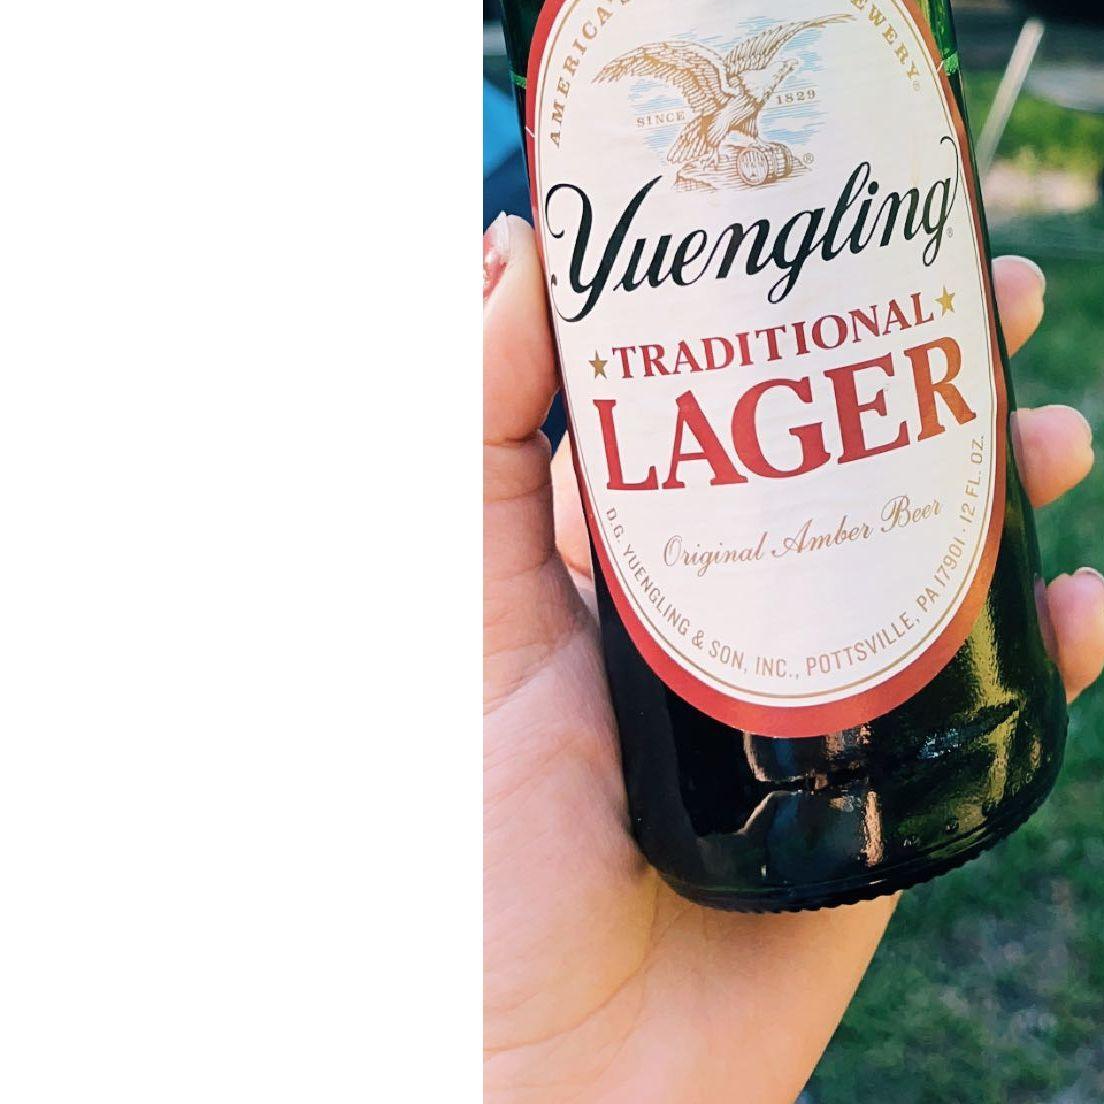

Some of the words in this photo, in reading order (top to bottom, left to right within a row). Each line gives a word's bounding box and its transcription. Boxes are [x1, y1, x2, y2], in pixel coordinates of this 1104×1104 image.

[636, 110, 686, 129] SINCE
[776, 89, 817, 105] 1829
[544, 135, 959, 323] Yuengling
[611, 291, 935, 380] TRADITIONAL
[591, 335, 978, 491] LAGER
[970, 435, 985, 464] OZ.
[964, 469, 982, 498] FL.
[606, 506, 624, 544] D.G.
[959, 502, 976, 524] 12
[662, 531, 766, 577] Original
[771, 518, 873, 558] Amber
[880, 495, 942, 533] Beer
[933, 536, 966, 588] 17901
[622, 543, 691, 637] YUENGLING
[916, 586, 939, 613] PA
[691, 629, 705, 650] &
[708, 639, 748, 675] SON,
[805, 611, 921, 678] POTTSVILLE,
